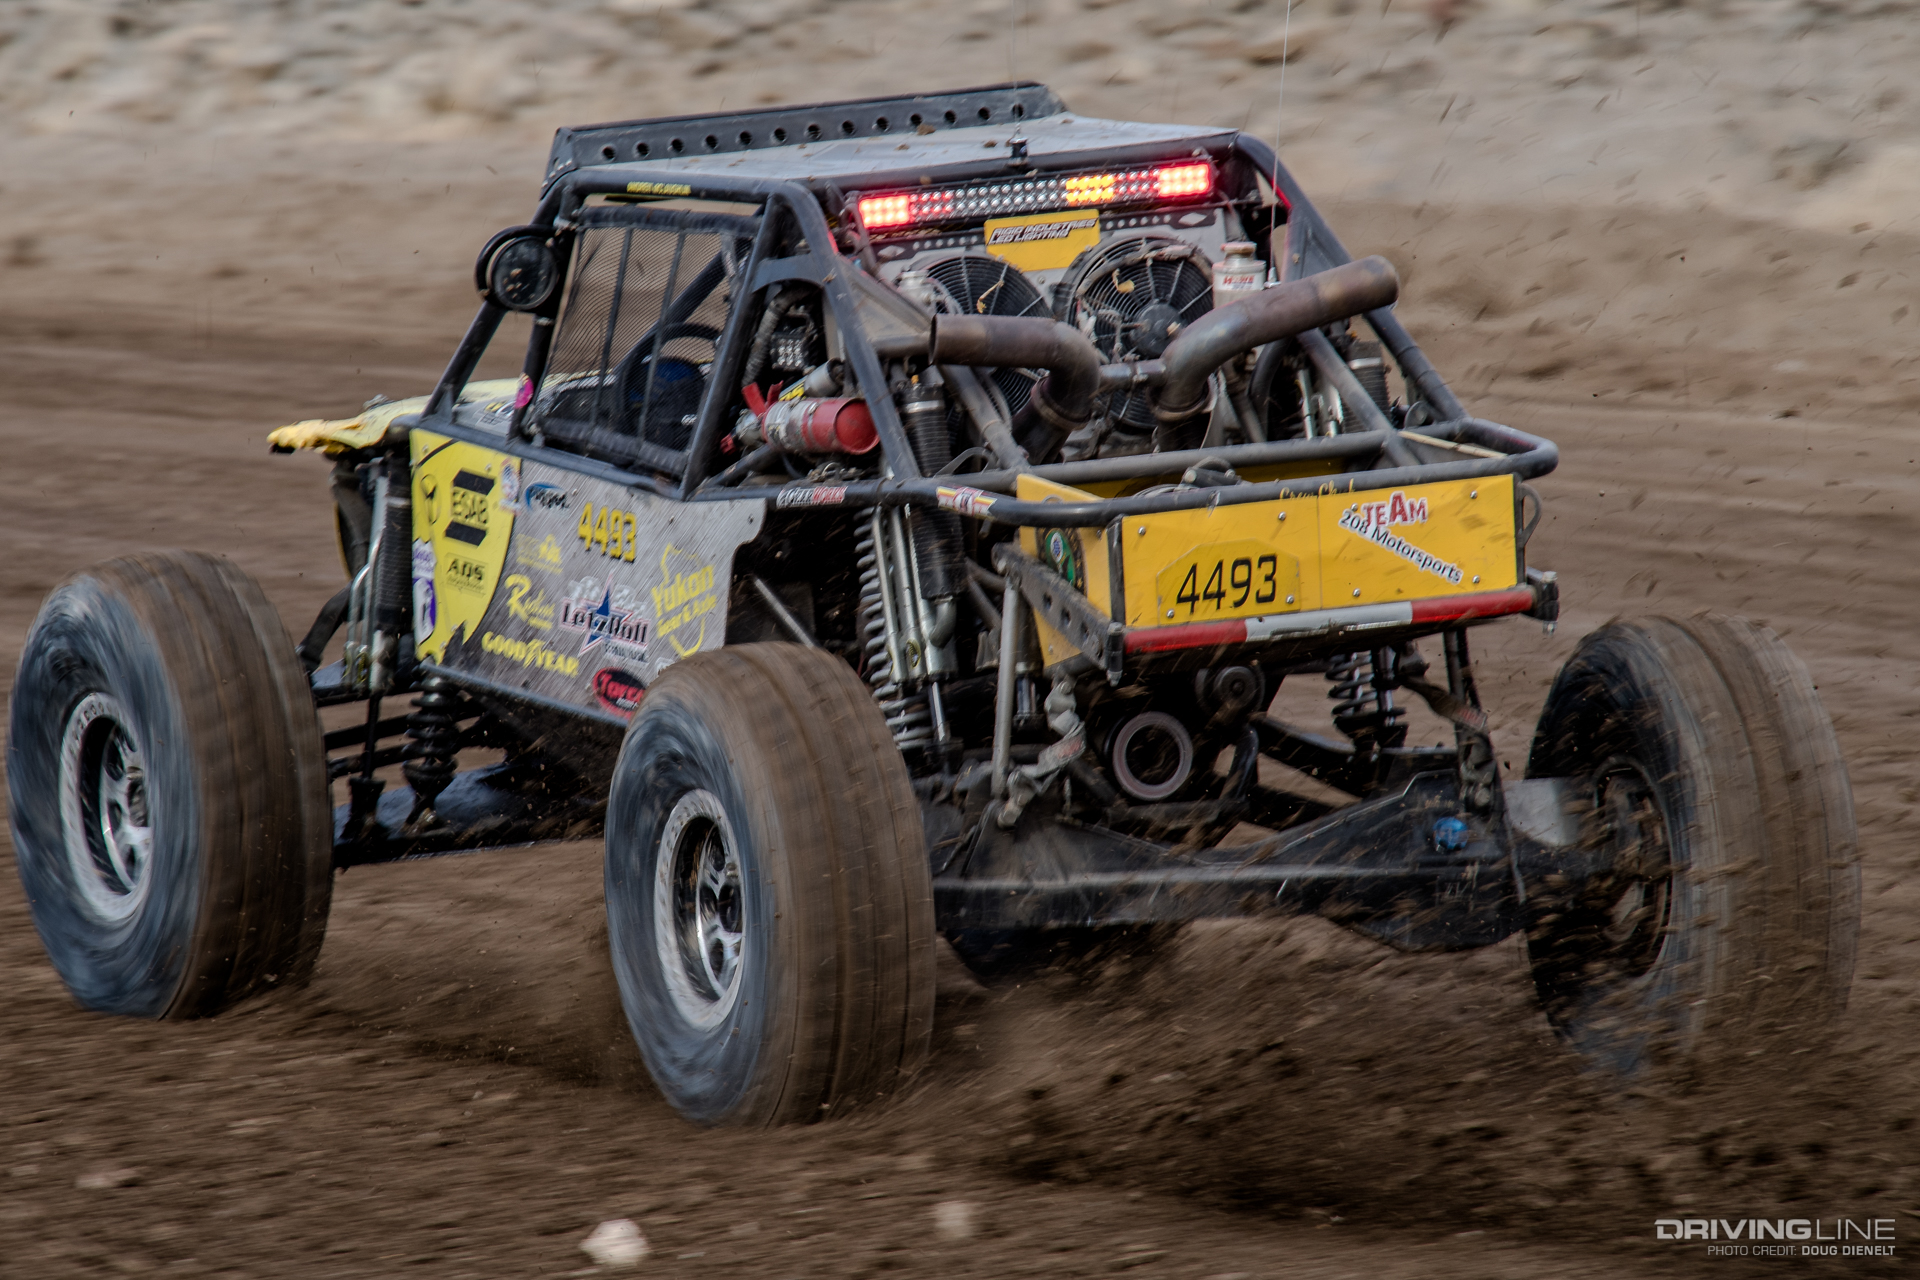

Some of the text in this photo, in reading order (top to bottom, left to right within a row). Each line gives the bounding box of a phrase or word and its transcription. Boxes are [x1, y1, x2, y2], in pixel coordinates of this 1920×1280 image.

[988, 230, 1070, 245] LED LIGHTING
[993, 218, 1099, 236] RIGID INDUSTRIES
[452, 488, 488, 525] ESAB
[1363, 492, 1427, 527] TEAM
[578, 502, 637, 564] 4493
[1340, 509, 1462, 583] 208 Motorsports
[651, 564, 714, 619] Yukon
[1176, 553, 1278, 616] 4493
[482, 631, 580, 678] GOODYEAR
